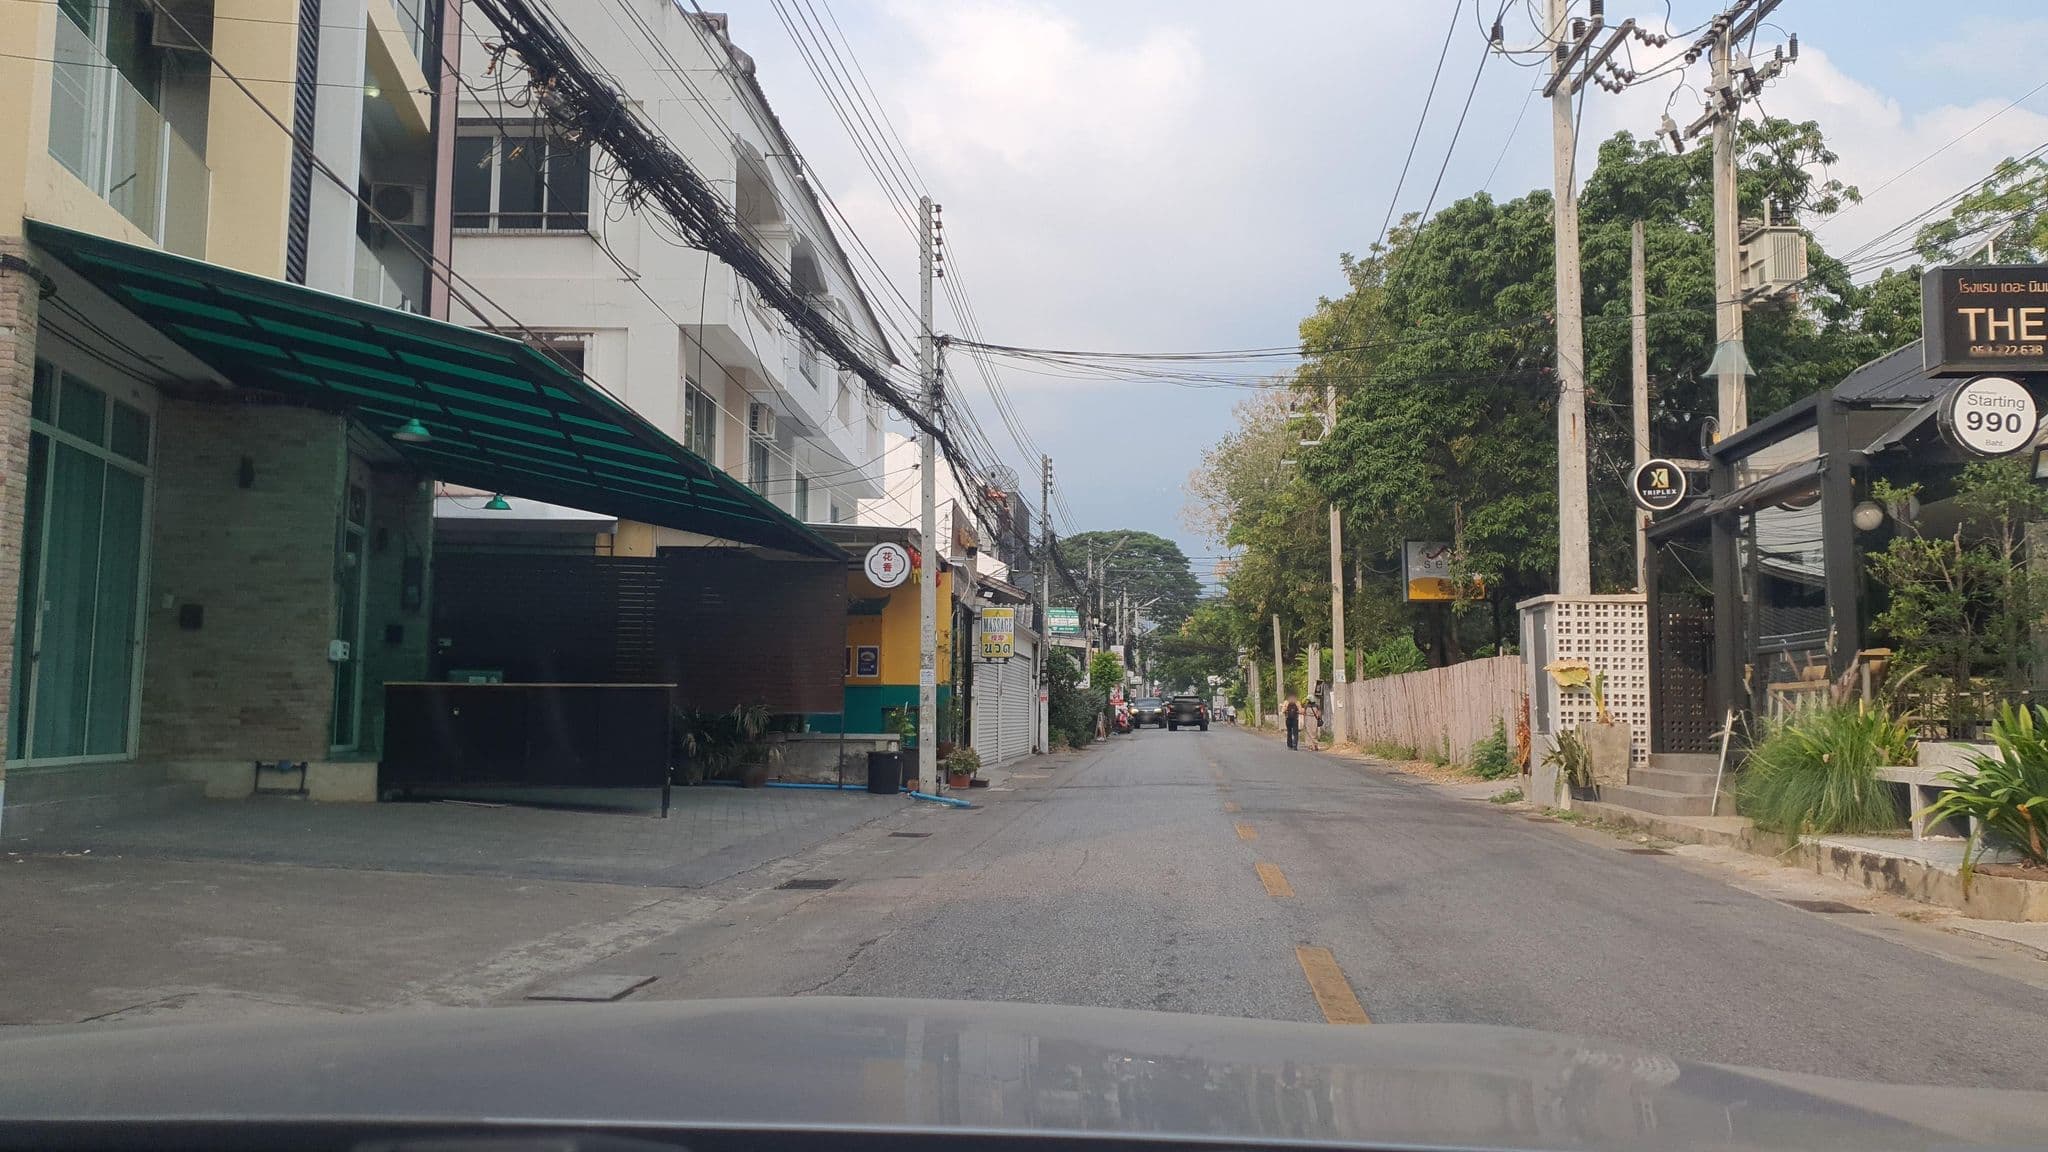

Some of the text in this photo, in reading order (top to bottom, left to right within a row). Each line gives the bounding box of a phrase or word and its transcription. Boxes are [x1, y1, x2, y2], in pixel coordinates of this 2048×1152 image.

[1958, 307, 2047, 341] THE
[1967, 393, 2025, 411] Starting
[1967, 411, 2021, 433] 990
[1642, 488, 1677, 496] TRIPLEX
[983, 617, 1012, 633] MASSAGE
